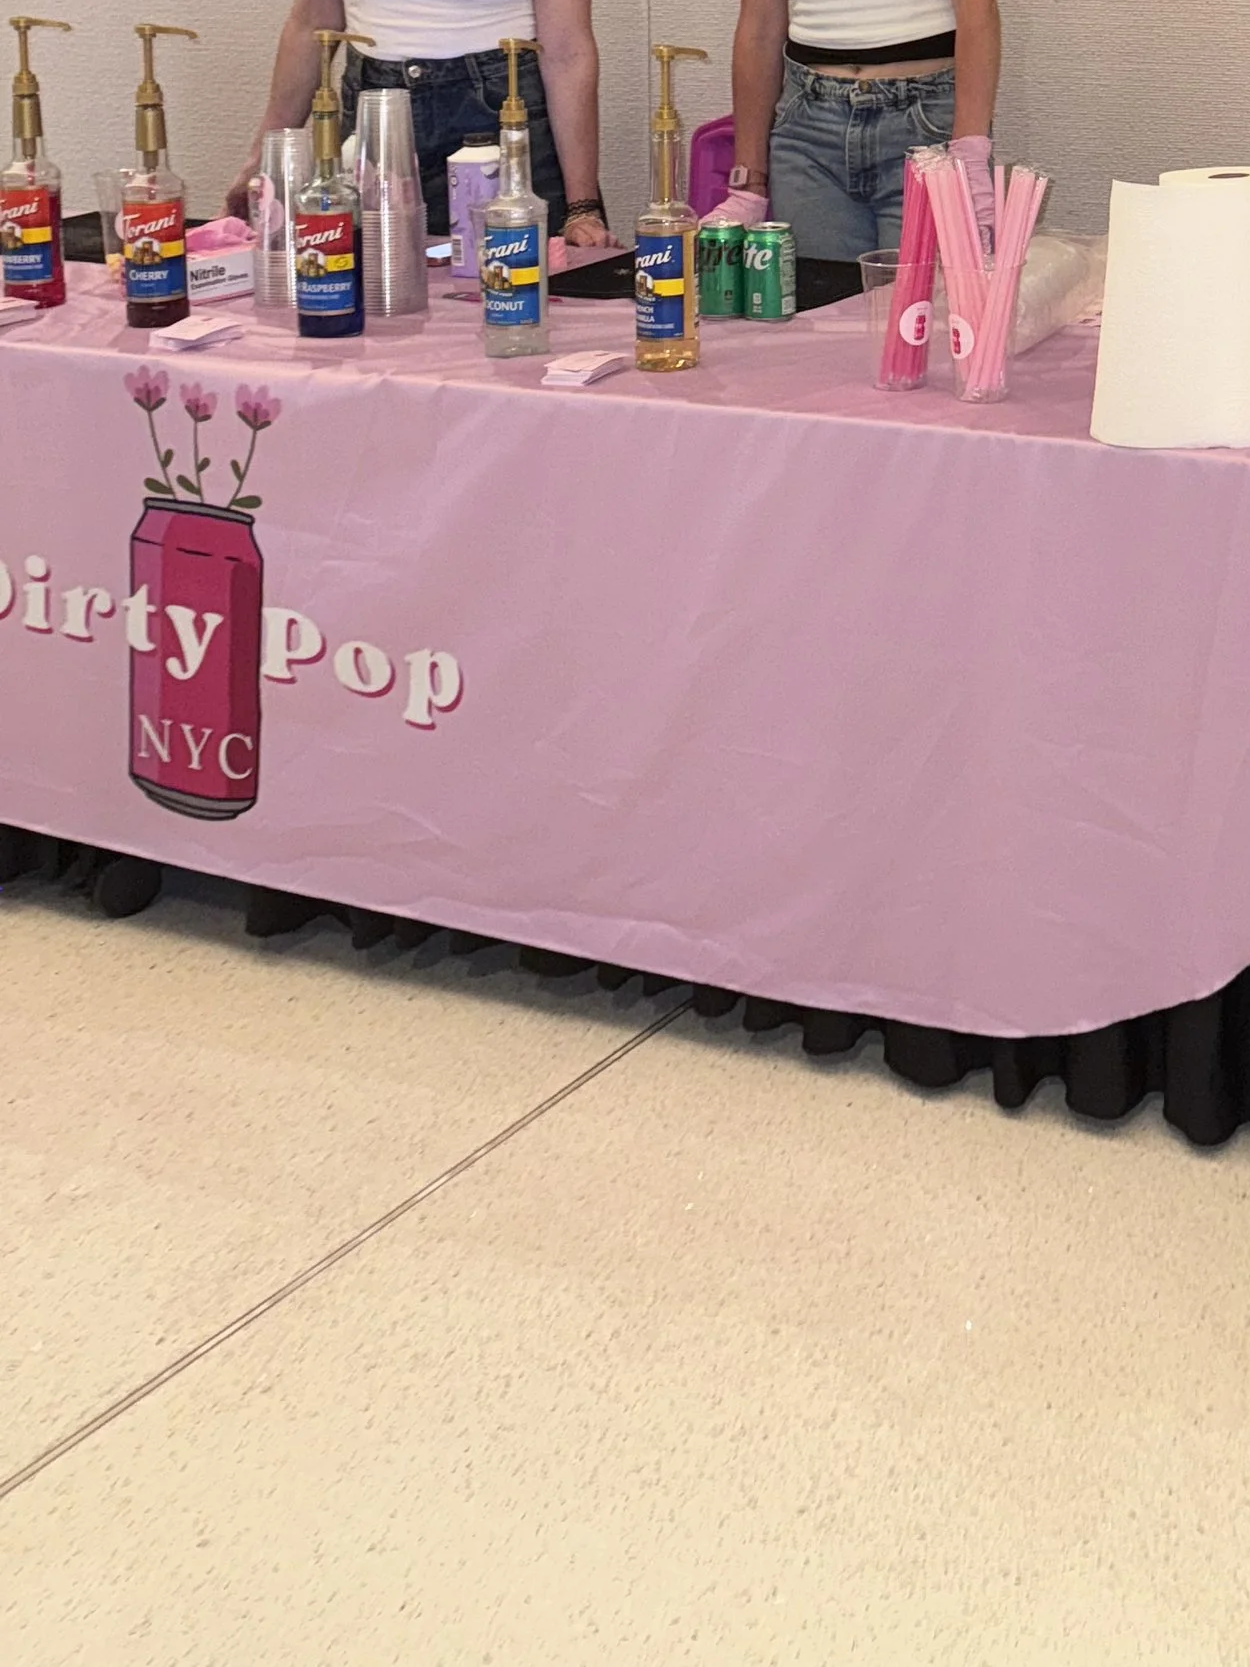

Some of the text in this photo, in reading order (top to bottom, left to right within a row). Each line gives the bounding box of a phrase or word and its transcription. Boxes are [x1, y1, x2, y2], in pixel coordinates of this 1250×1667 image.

[124, 209, 177, 239] Torani
[190, 265, 226, 282] Nitrile
[261, 607, 464, 730] Pop
[137, 714, 255, 780] NYC
